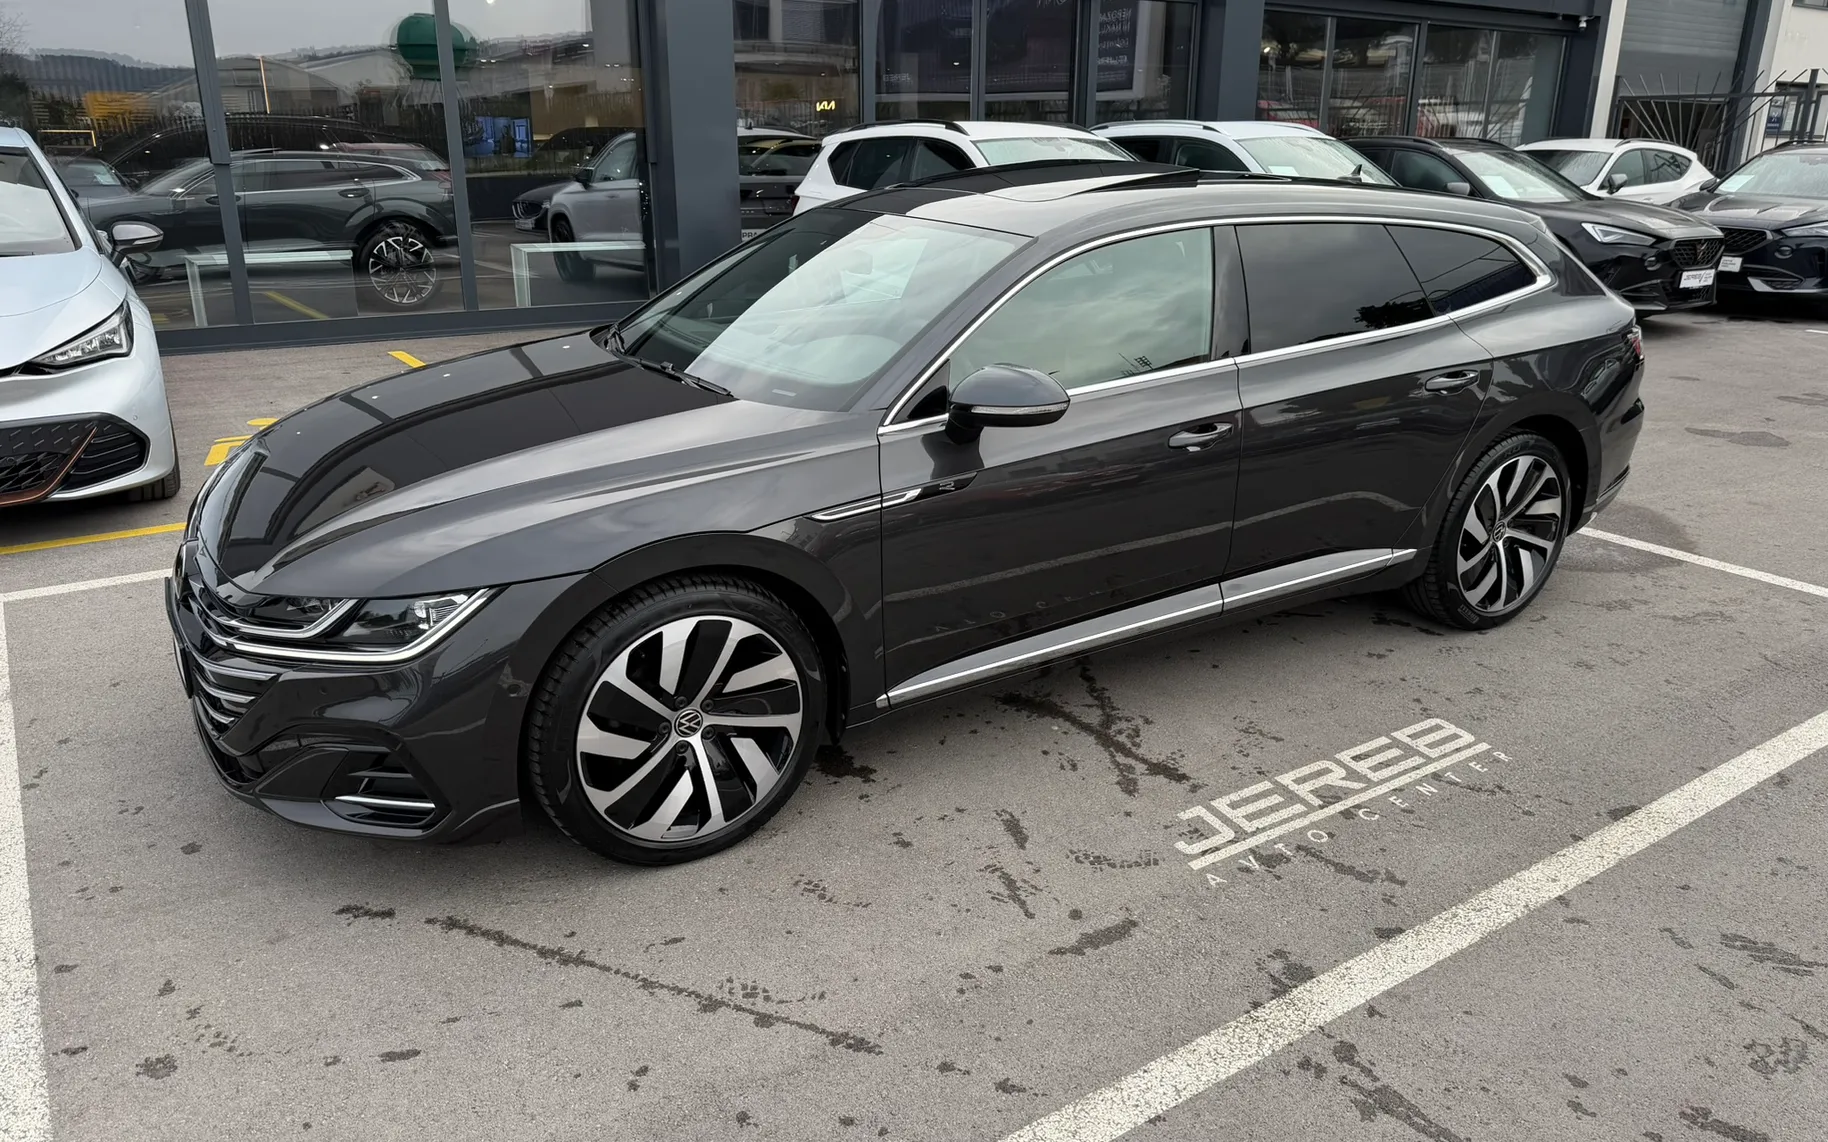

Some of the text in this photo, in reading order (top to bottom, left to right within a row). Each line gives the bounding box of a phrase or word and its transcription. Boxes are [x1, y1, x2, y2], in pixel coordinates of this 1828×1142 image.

[1174, 718, 1476, 854] JEREB
[1204, 750, 1514, 888] AVTO CENTER
